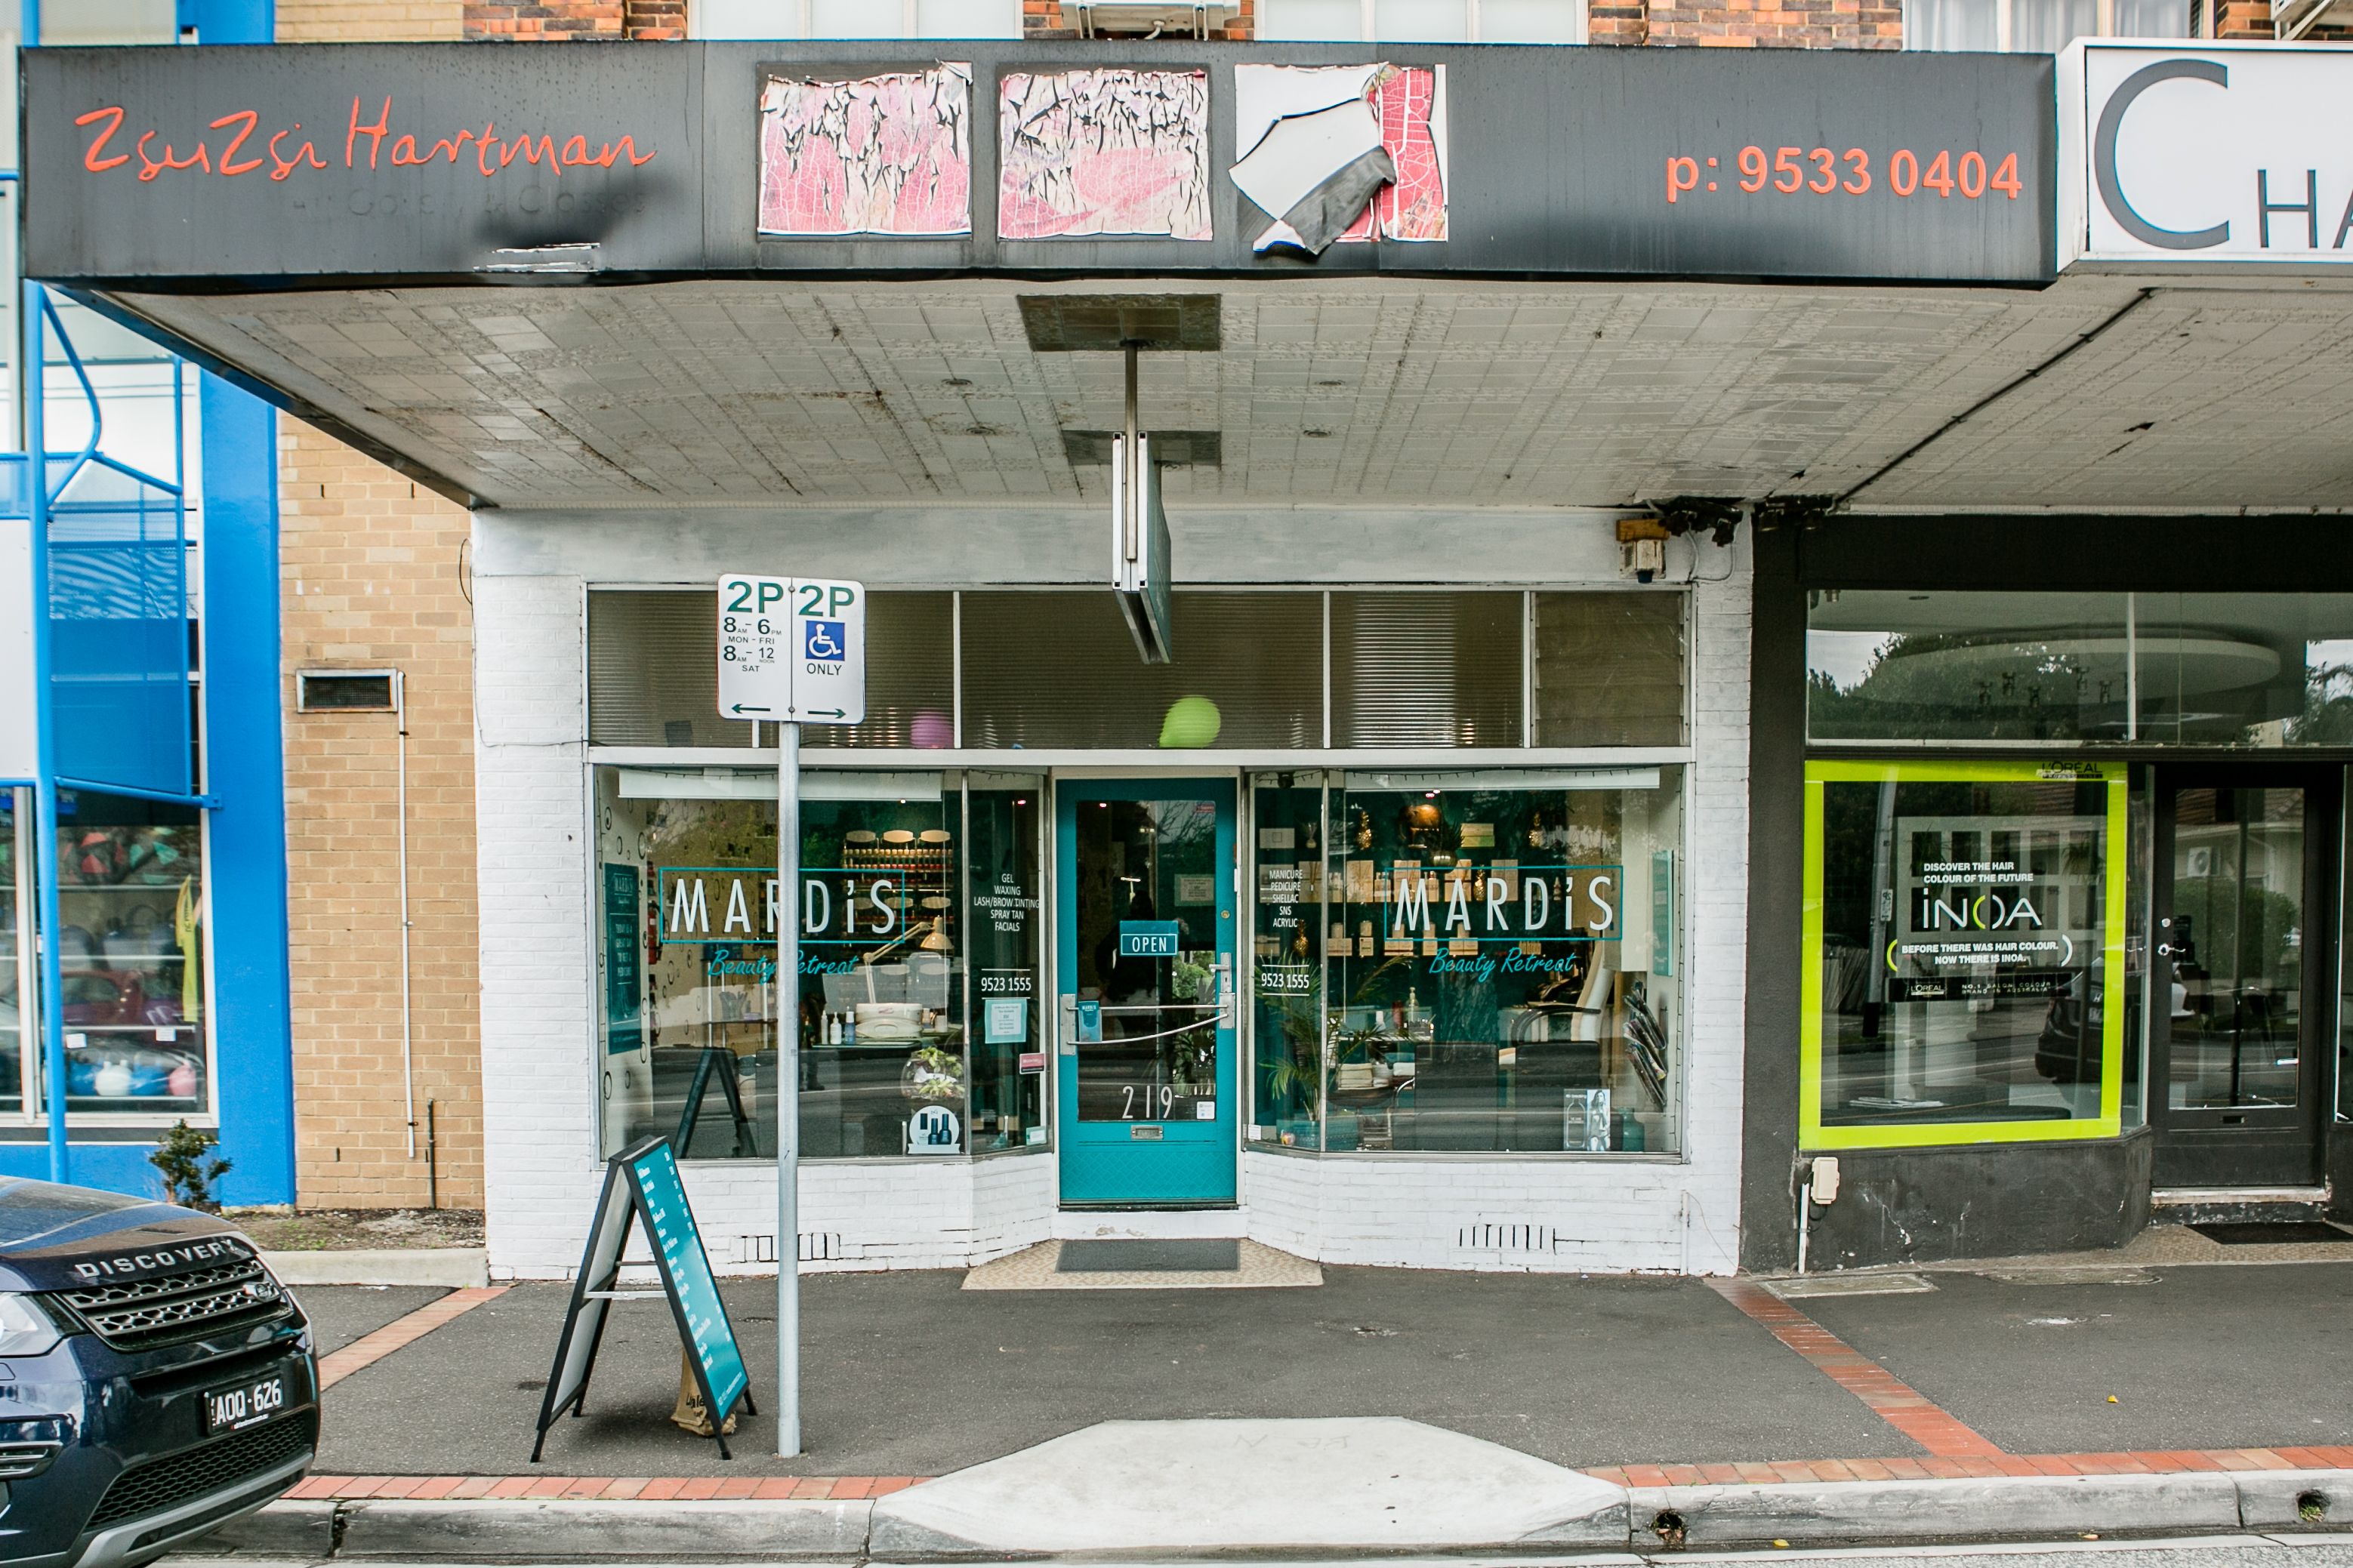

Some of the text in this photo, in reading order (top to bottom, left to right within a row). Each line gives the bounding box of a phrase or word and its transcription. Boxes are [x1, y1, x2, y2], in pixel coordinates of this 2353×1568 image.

[76, 95, 658, 182] ZsuZsi Hartman
[1667, 146, 2023, 202] p: 9533 0404
[727, 581, 784, 614] 2P
[798, 585, 855, 618] 2P
[759, 647, 774, 658] 12
[806, 663, 842, 676] ONLY
[1923, 861, 2014, 872] DISCOVER THE HAIR
[1001, 873, 1013, 883] GEL
[1269, 870, 1303, 879] MANICURE
[1923, 873, 2034, 883] COLOUR OF THE FUTURE
[994, 886, 1021, 895] WAXING
[1271, 882, 1301, 892] PEDICURE
[973, 897, 1013, 908] LASH/BROW
[1272, 894, 1299, 904] SHELLAC
[991, 910, 1024, 920] SPRAY TAN
[1279, 906, 1292, 916] SNS
[995, 922, 1020, 932] FACIALS
[1272, 918, 1298, 928] ACRYLIC
[1132, 937, 1167, 953] OPEN
[1901, 941, 2058, 953] BEFORE THERE WAS HAIR COLOUR.
[1429, 947, 1577, 982] Beauty Retreat
[1935, 953, 2027, 965] NOW THERE IS INOA.
[708, 950, 859, 984] Beauty etreat
[981, 977, 1032, 992] 9523 1555
[1261, 972, 1309, 989] 9523 1555
[1122, 1086, 1173, 1119] 219
[74, 1239, 235, 1278] DISCOVERY
